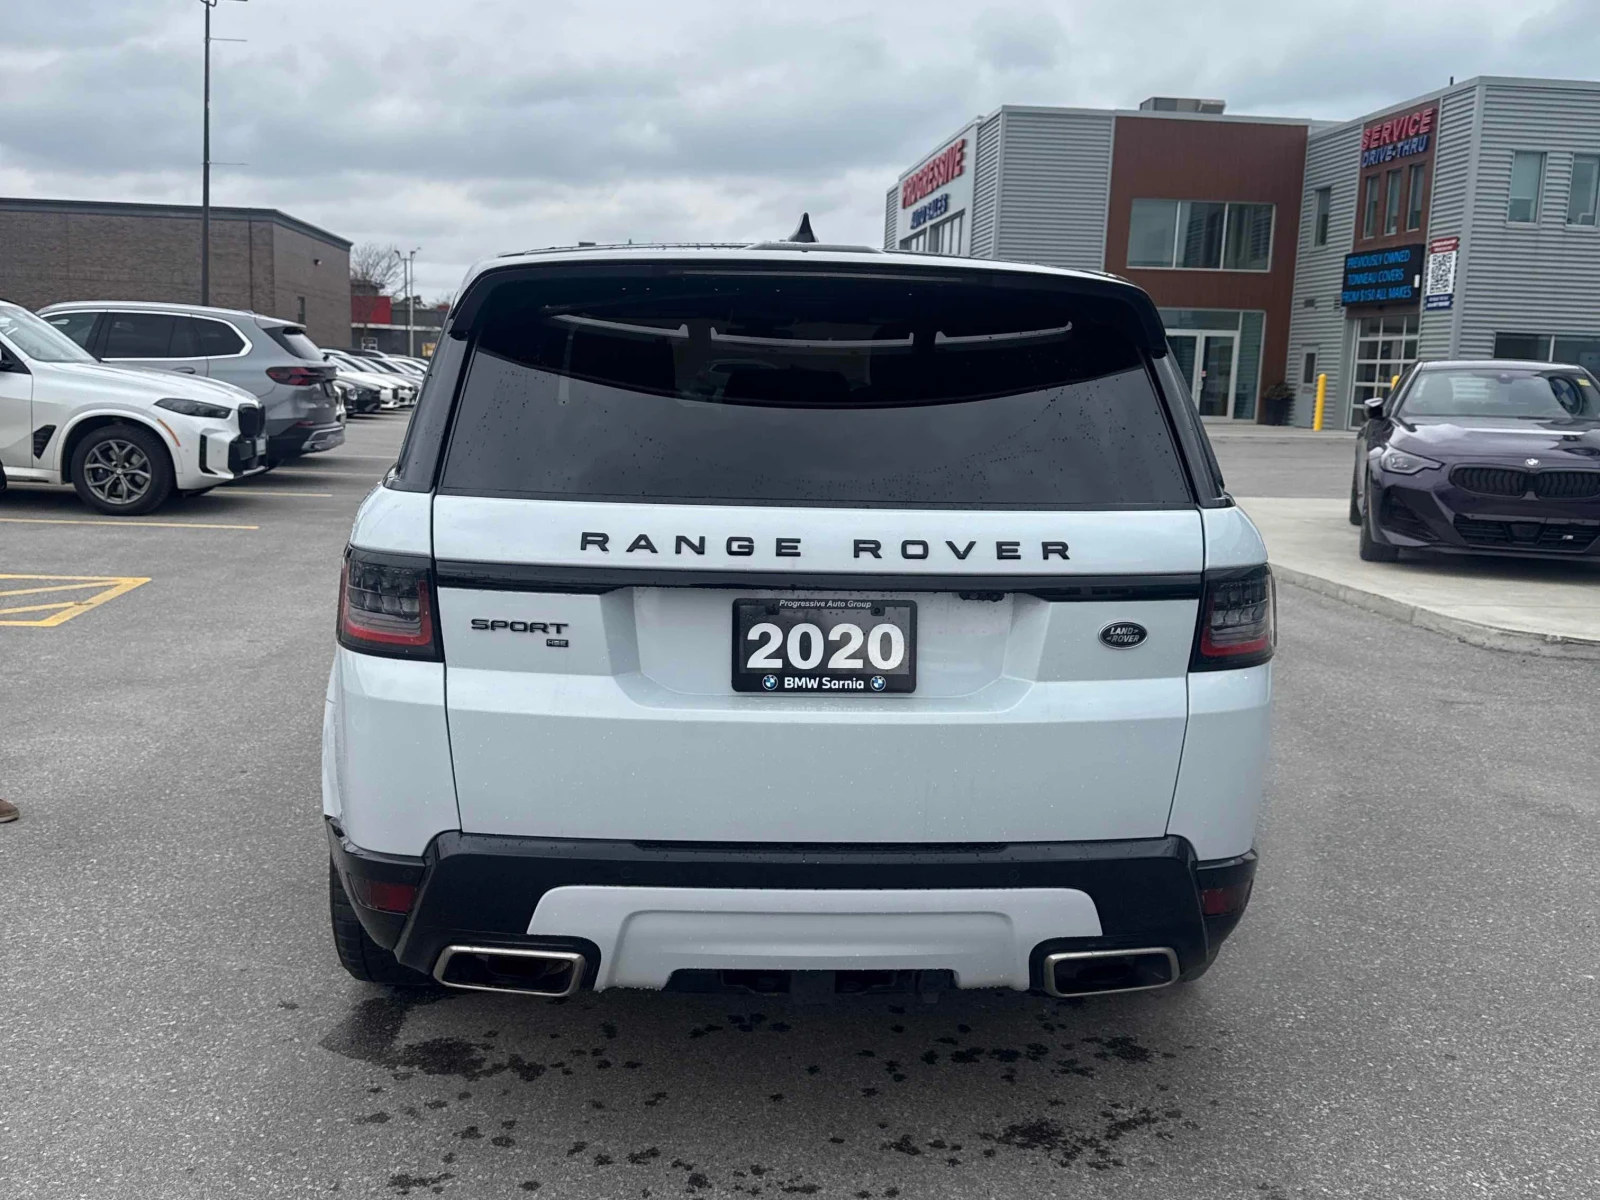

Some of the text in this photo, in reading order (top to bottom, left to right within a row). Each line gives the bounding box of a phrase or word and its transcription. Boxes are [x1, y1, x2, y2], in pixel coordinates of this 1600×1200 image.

[1361, 108, 1434, 151] SERVICE
[1361, 135, 1429, 168] DRIVE-THRU
[902, 139, 965, 209] PROGRESSIVE
[1347, 250, 1411, 269] PREVIOUSLY OWNED
[1378, 268, 1404, 283] COVERS
[1388, 285, 1412, 299] MAKES
[580, 531, 1071, 561] RANGE ROVER
[779, 599, 872, 609] Progressive Auto Group
[471, 618, 569, 634] SPORT
[1110, 627, 1133, 635] LAND
[746, 623, 905, 670] 2020
[1111, 635, 1140, 643] ROVER
[784, 676, 865, 689] BMW Sarnia
